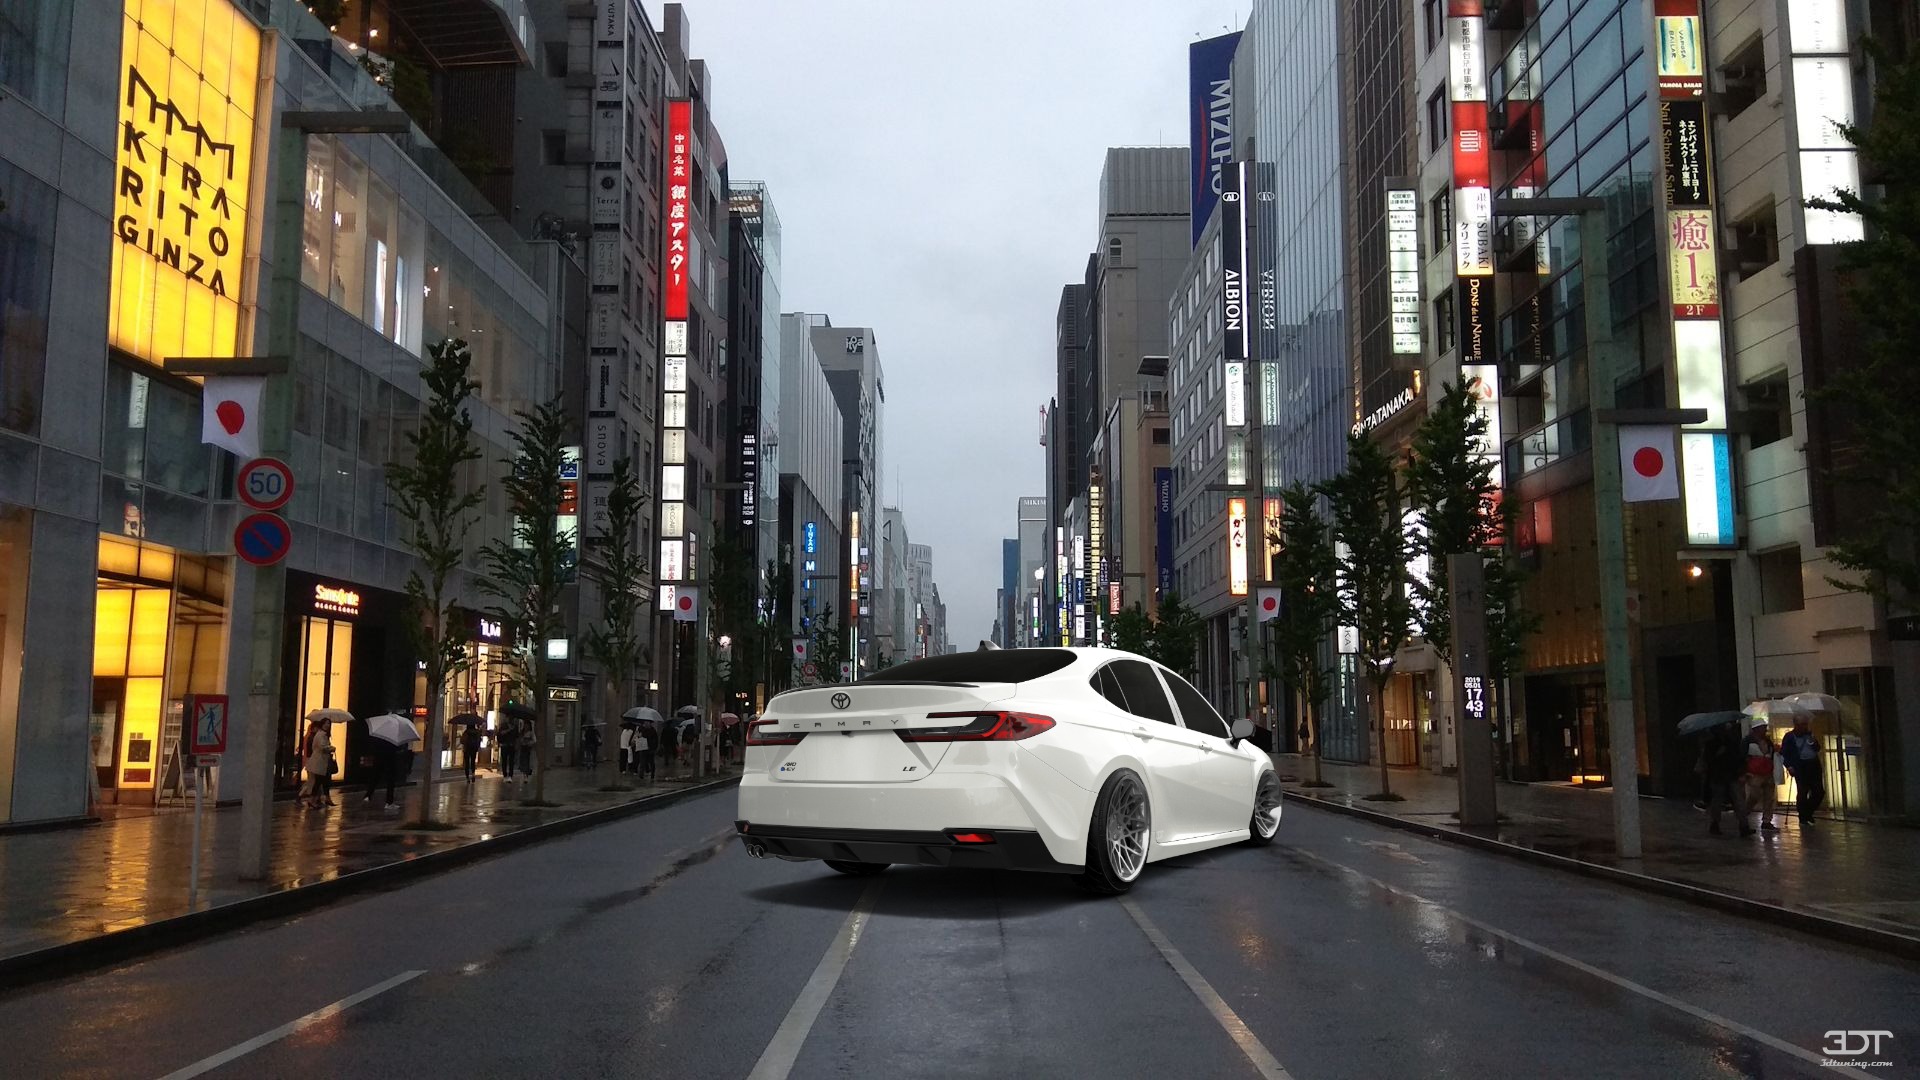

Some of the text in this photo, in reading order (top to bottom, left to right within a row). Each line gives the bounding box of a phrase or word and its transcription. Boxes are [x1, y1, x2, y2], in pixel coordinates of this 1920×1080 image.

[607, 2, 616, 37] YUTAKA
[123, 120, 230, 220] KIRA
[1661, 102, 1676, 206] Nail School Salon
[1679, 119, 1691, 187] ネイルスクール東京
[120, 165, 229, 257] RITO
[670, 133, 687, 286] 中国名菜 銀座アスター
[118, 214, 226, 297] GINZA
[1460, 221, 1471, 270] クリニック
[1477, 215, 1489, 270] TSUBAKI
[1225, 268, 1241, 330] ALBION
[1469, 278, 1480, 307] DONS
[1376, 387, 1414, 423] TANAKA
[250, 472, 282, 495] 50
[1161, 479, 1169, 513] MIZUHO
[1232, 516, 1246, 548] がんこ
[1465, 700, 1484, 712] 43
[1466, 688, 1483, 700] 17
[793, 719, 899, 729] CAMRY
